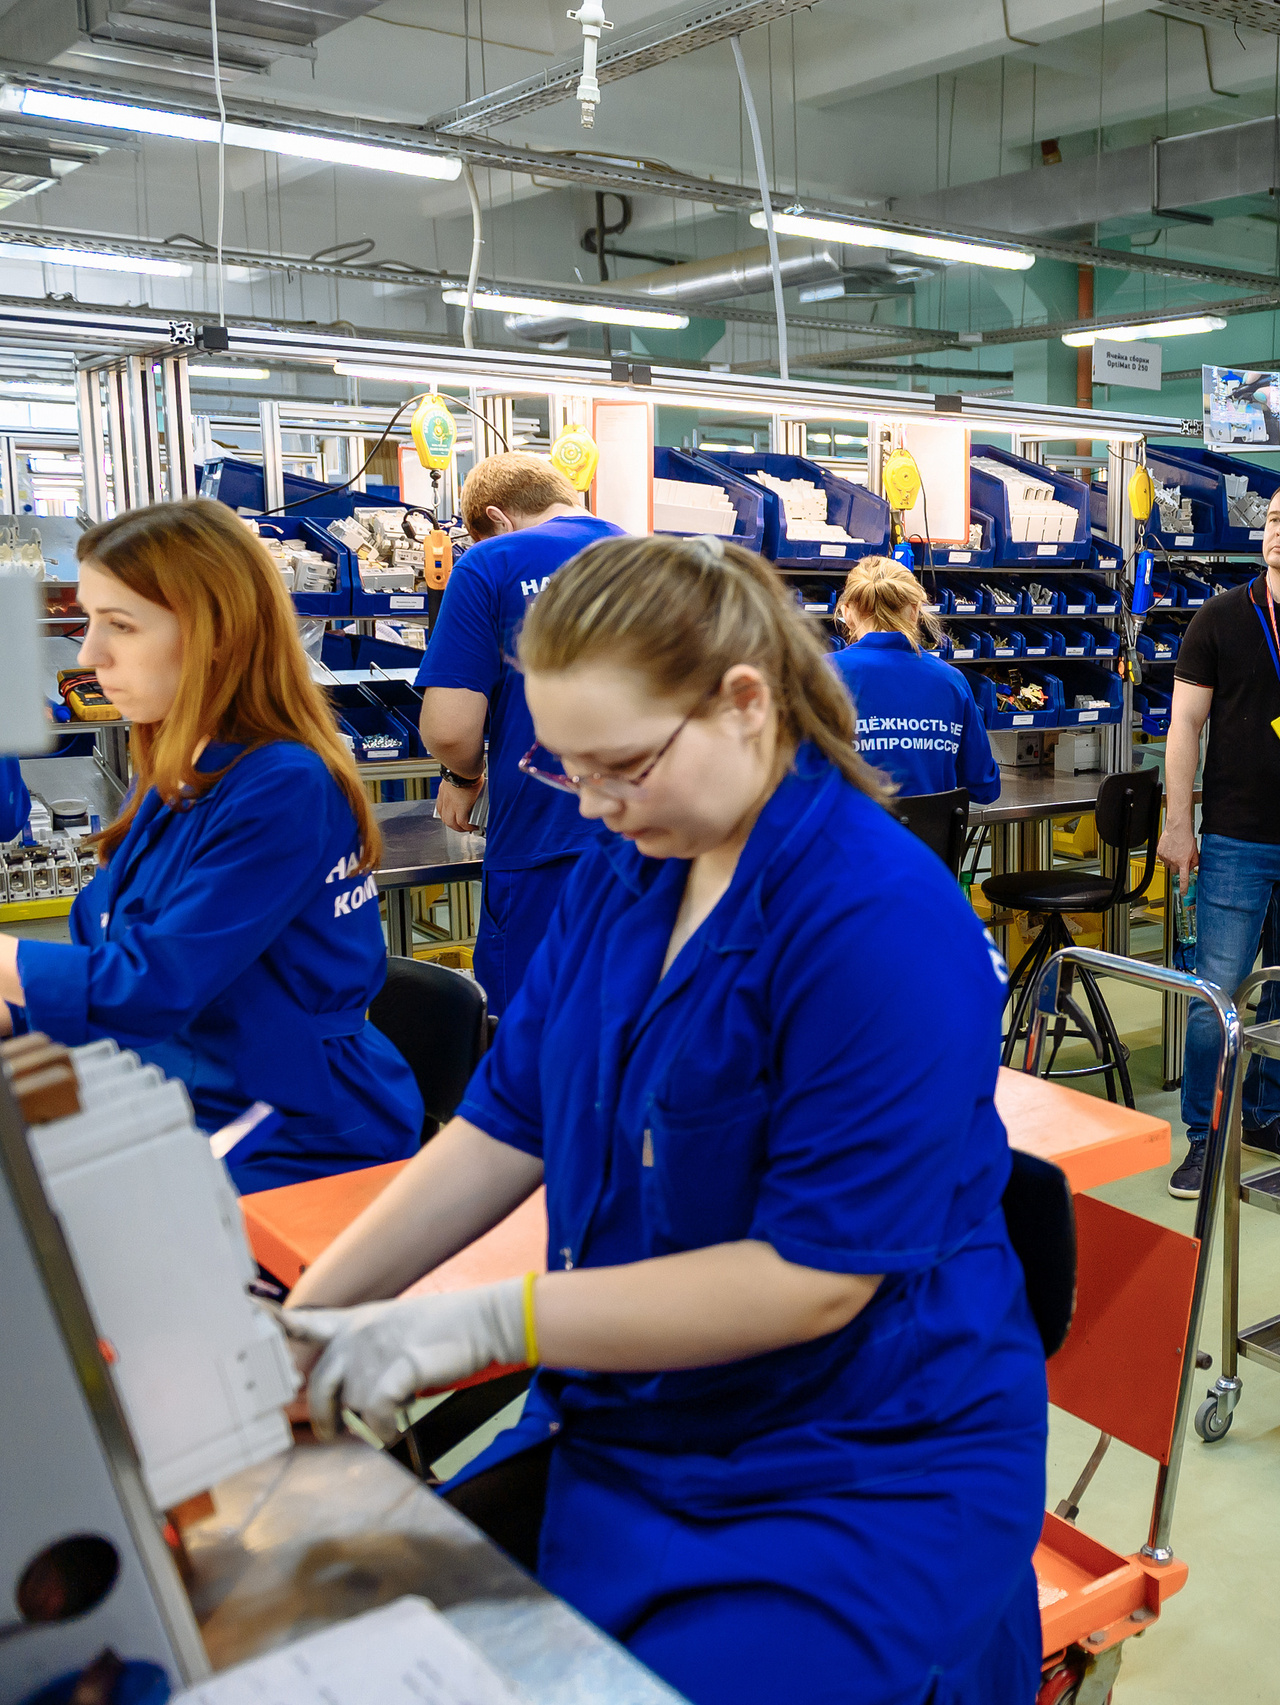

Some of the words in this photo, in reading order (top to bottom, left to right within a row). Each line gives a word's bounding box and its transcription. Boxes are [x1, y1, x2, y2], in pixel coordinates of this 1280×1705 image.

[1106, 351, 1128, 361] Ячейка
[1129, 355, 1150, 364] сборки
[1107, 360, 1131, 369] OptiMat
[1131, 362, 1137, 370] D
[1137, 363, 1149, 372] 250
[854, 716, 948, 734] ДЁЖНОСТЬ
